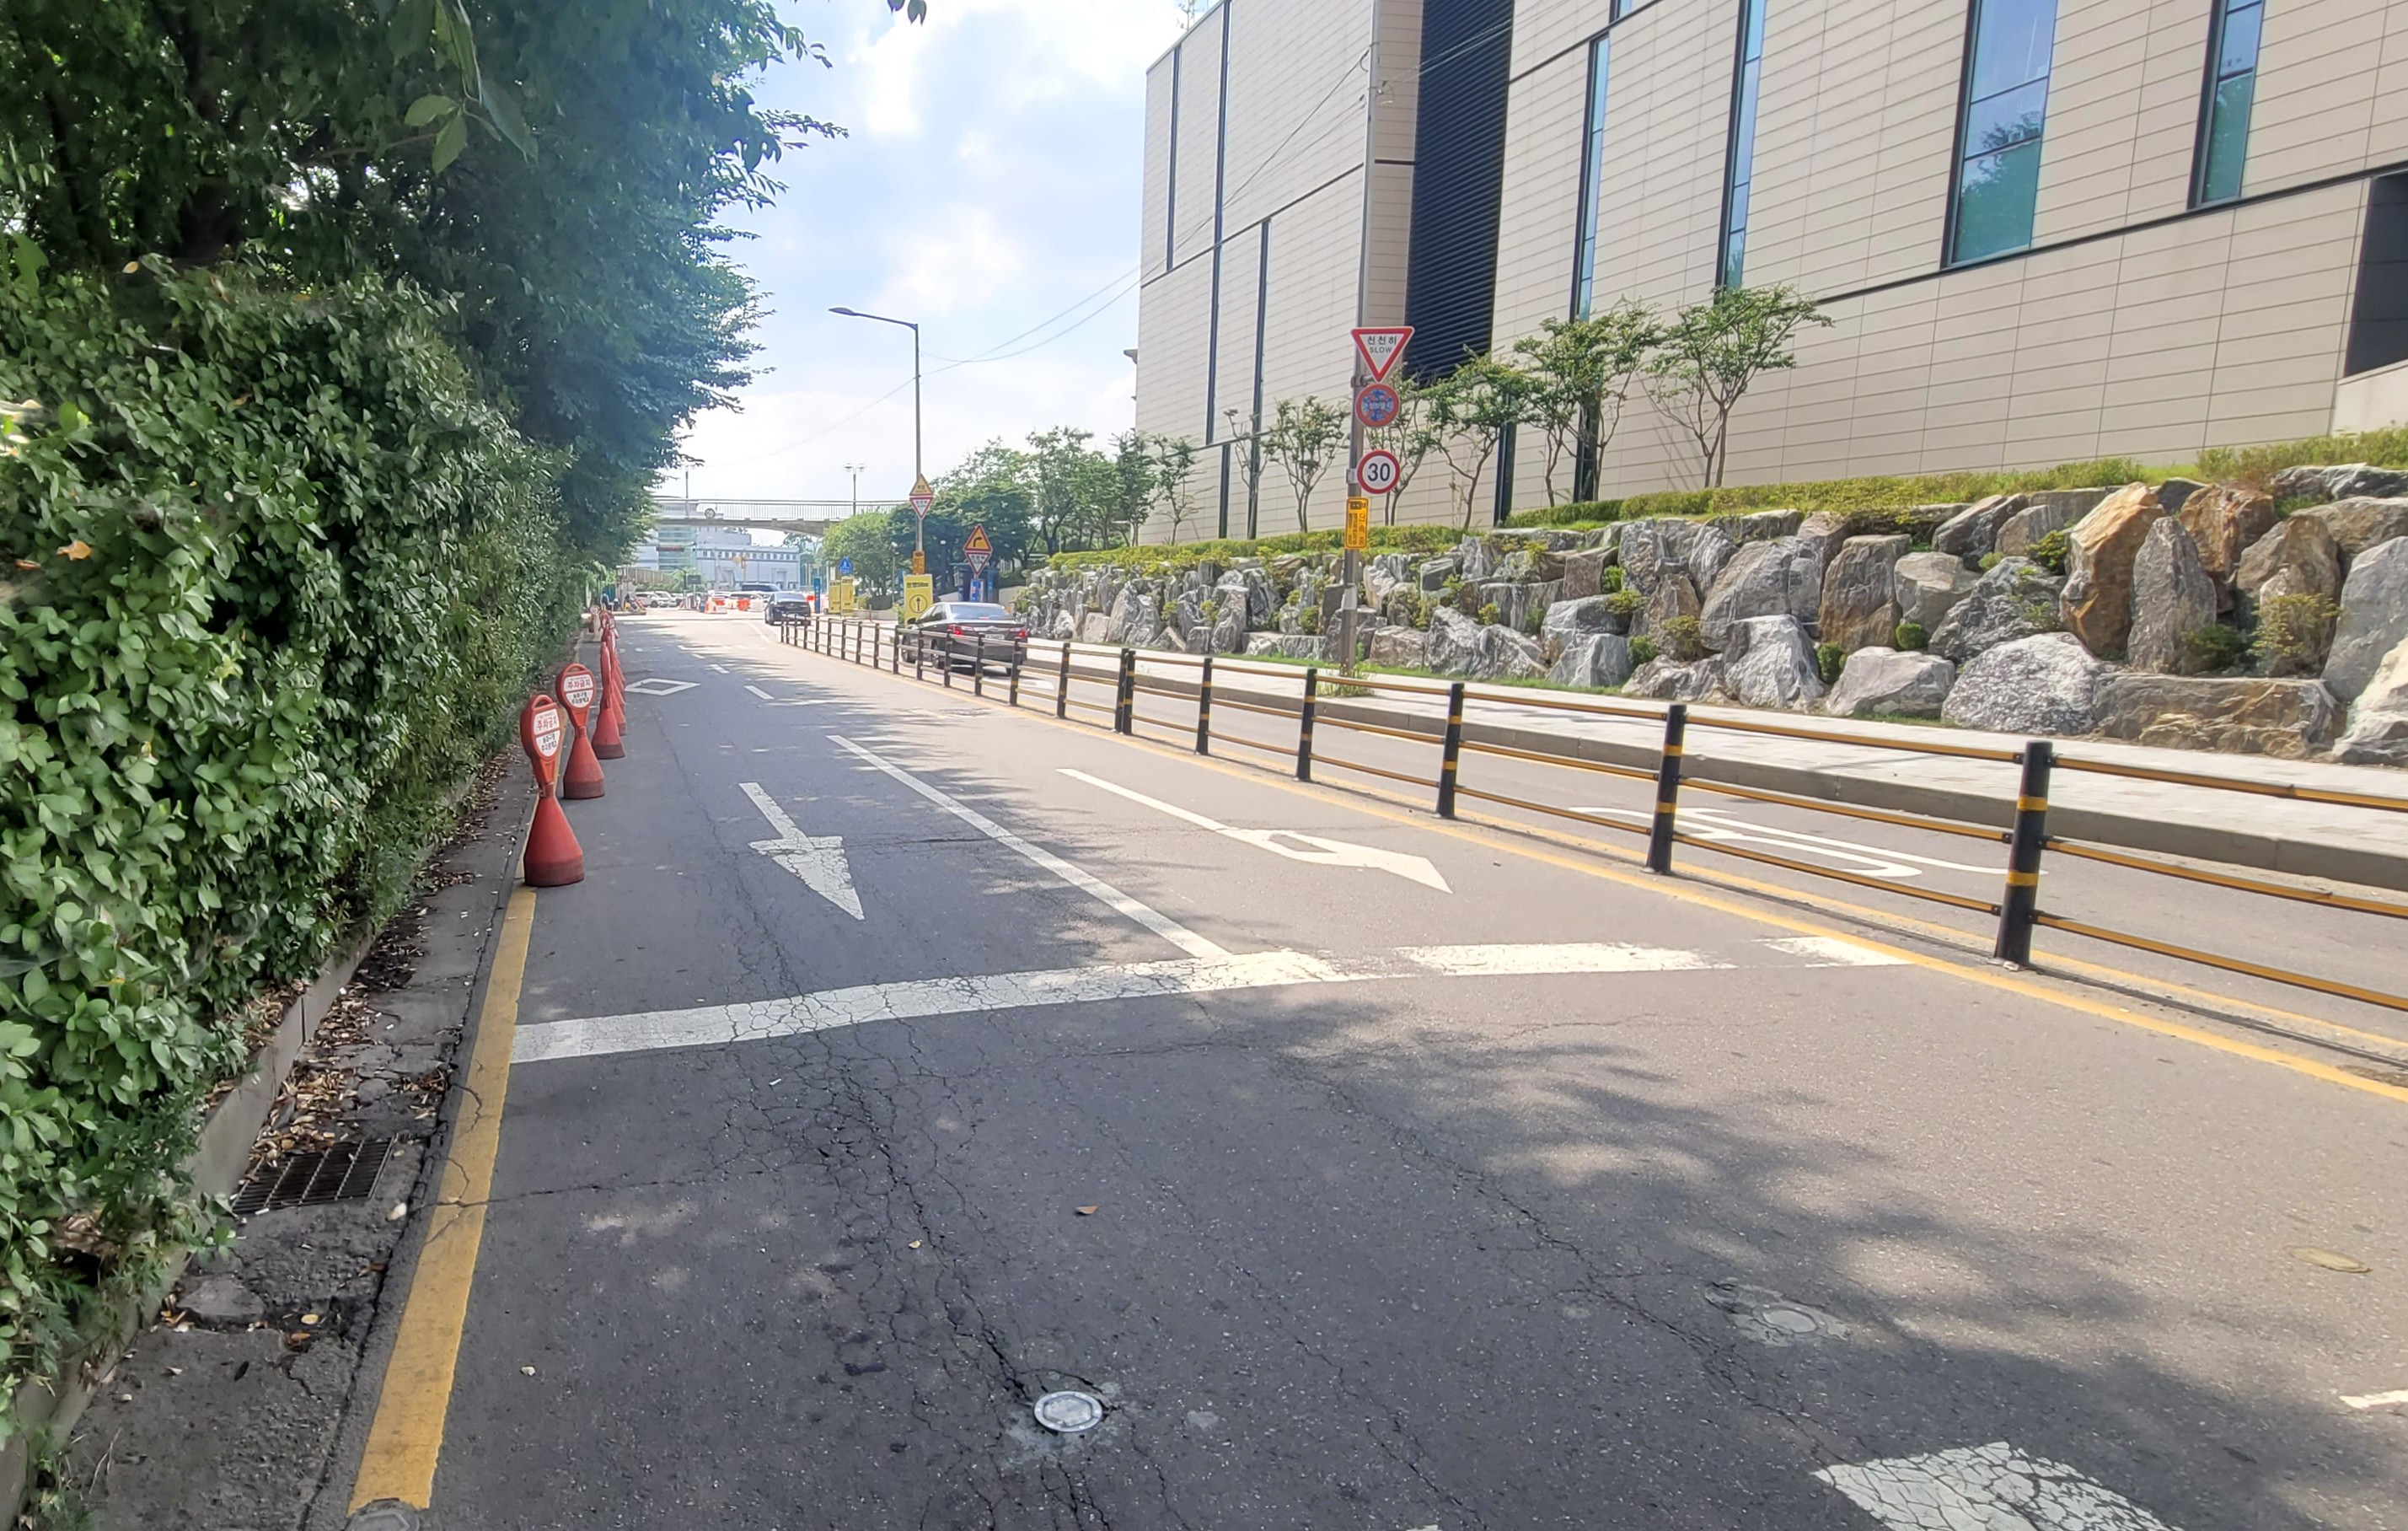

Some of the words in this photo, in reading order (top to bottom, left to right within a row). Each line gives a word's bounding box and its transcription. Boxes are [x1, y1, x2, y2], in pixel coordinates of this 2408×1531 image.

[1366, 335, 1397, 345] 천천히
[1368, 463, 1390, 481] 30
[567, 679, 591, 689] 주차금지
